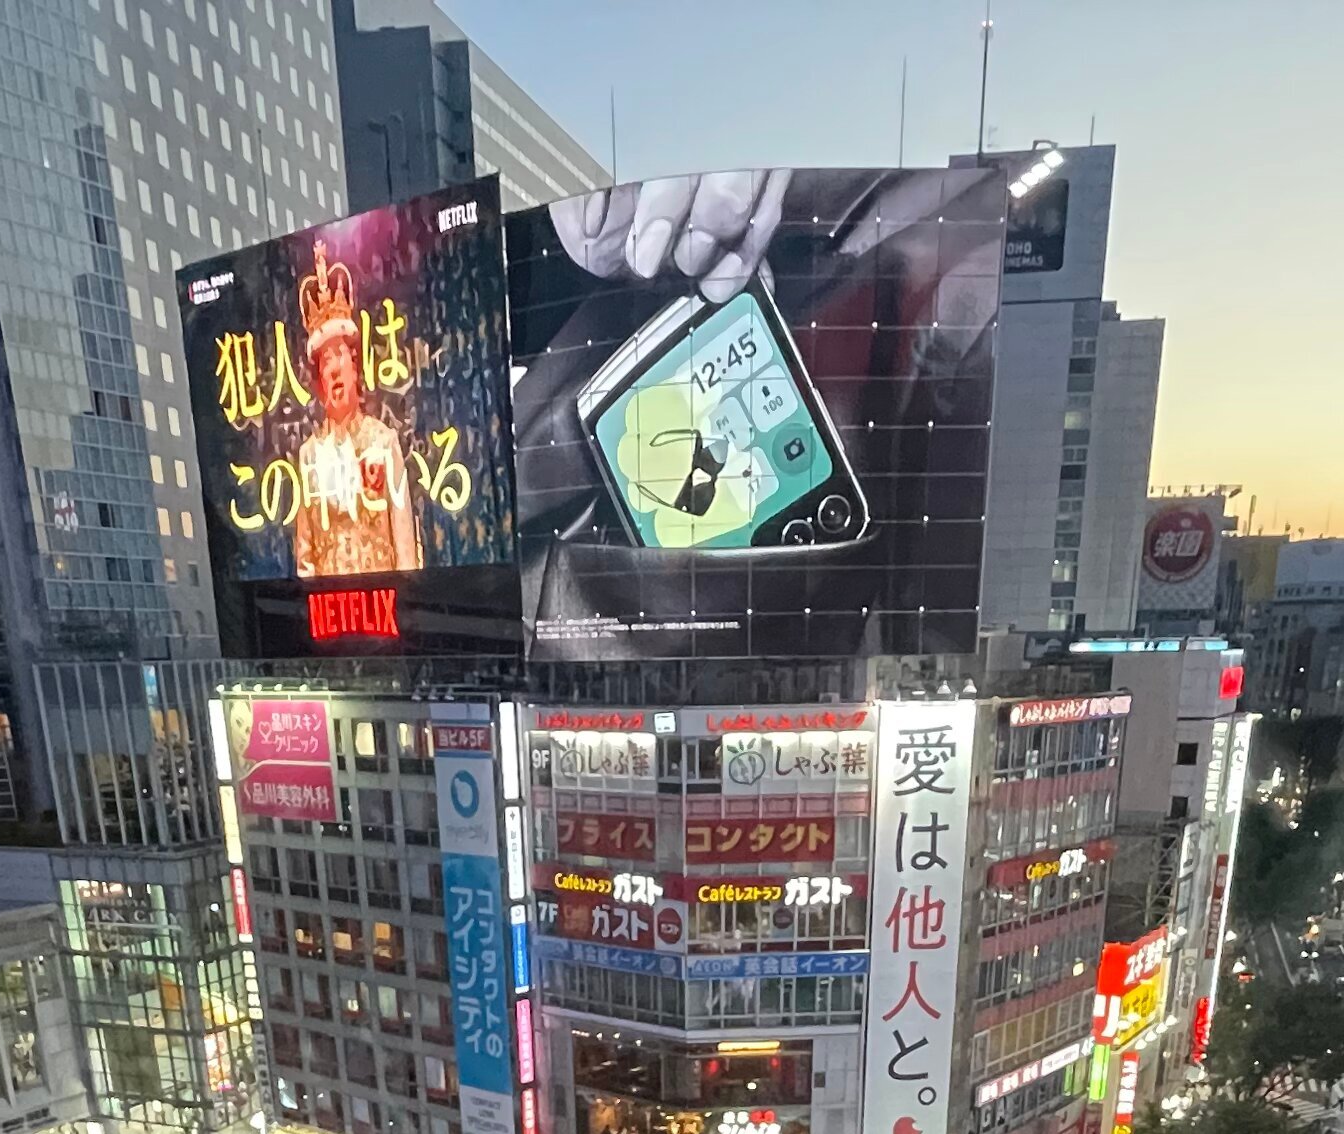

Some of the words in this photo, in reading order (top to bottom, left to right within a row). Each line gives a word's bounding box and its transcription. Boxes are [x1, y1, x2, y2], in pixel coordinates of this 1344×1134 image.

[438, 201, 478, 233] NETFLIX
[1006, 241, 1032, 255] OHO
[215, 298, 409, 422] 犯人は
[690, 331, 757, 394] 12:45
[762, 395, 784, 416] 100
[229, 426, 472, 531] この中にいる
[1153, 530, 1205, 557] 楽園
[308, 588, 400, 639] NETFLIX
[272, 713, 322, 732] 品川スキン
[275, 735, 319, 754] クリニック
[531, 749, 550, 768] 9F
[776, 742, 868, 777] しゃぶ葉
[252, 782, 330, 811] 品川美容外科
[687, 823, 831, 853] コンタクト
[613, 873, 664, 906] ガスト
[784, 877, 853, 906] ガスト
[538, 902, 558, 923] 7F
[592, 905, 649, 942] ガスト
[881, 724, 957, 1107] 愛は他人と。
[450, 886, 483, 1054] アイシティ
[476, 889, 504, 1058] コンタクトの
[744, 956, 865, 976] 英会話イーオン
